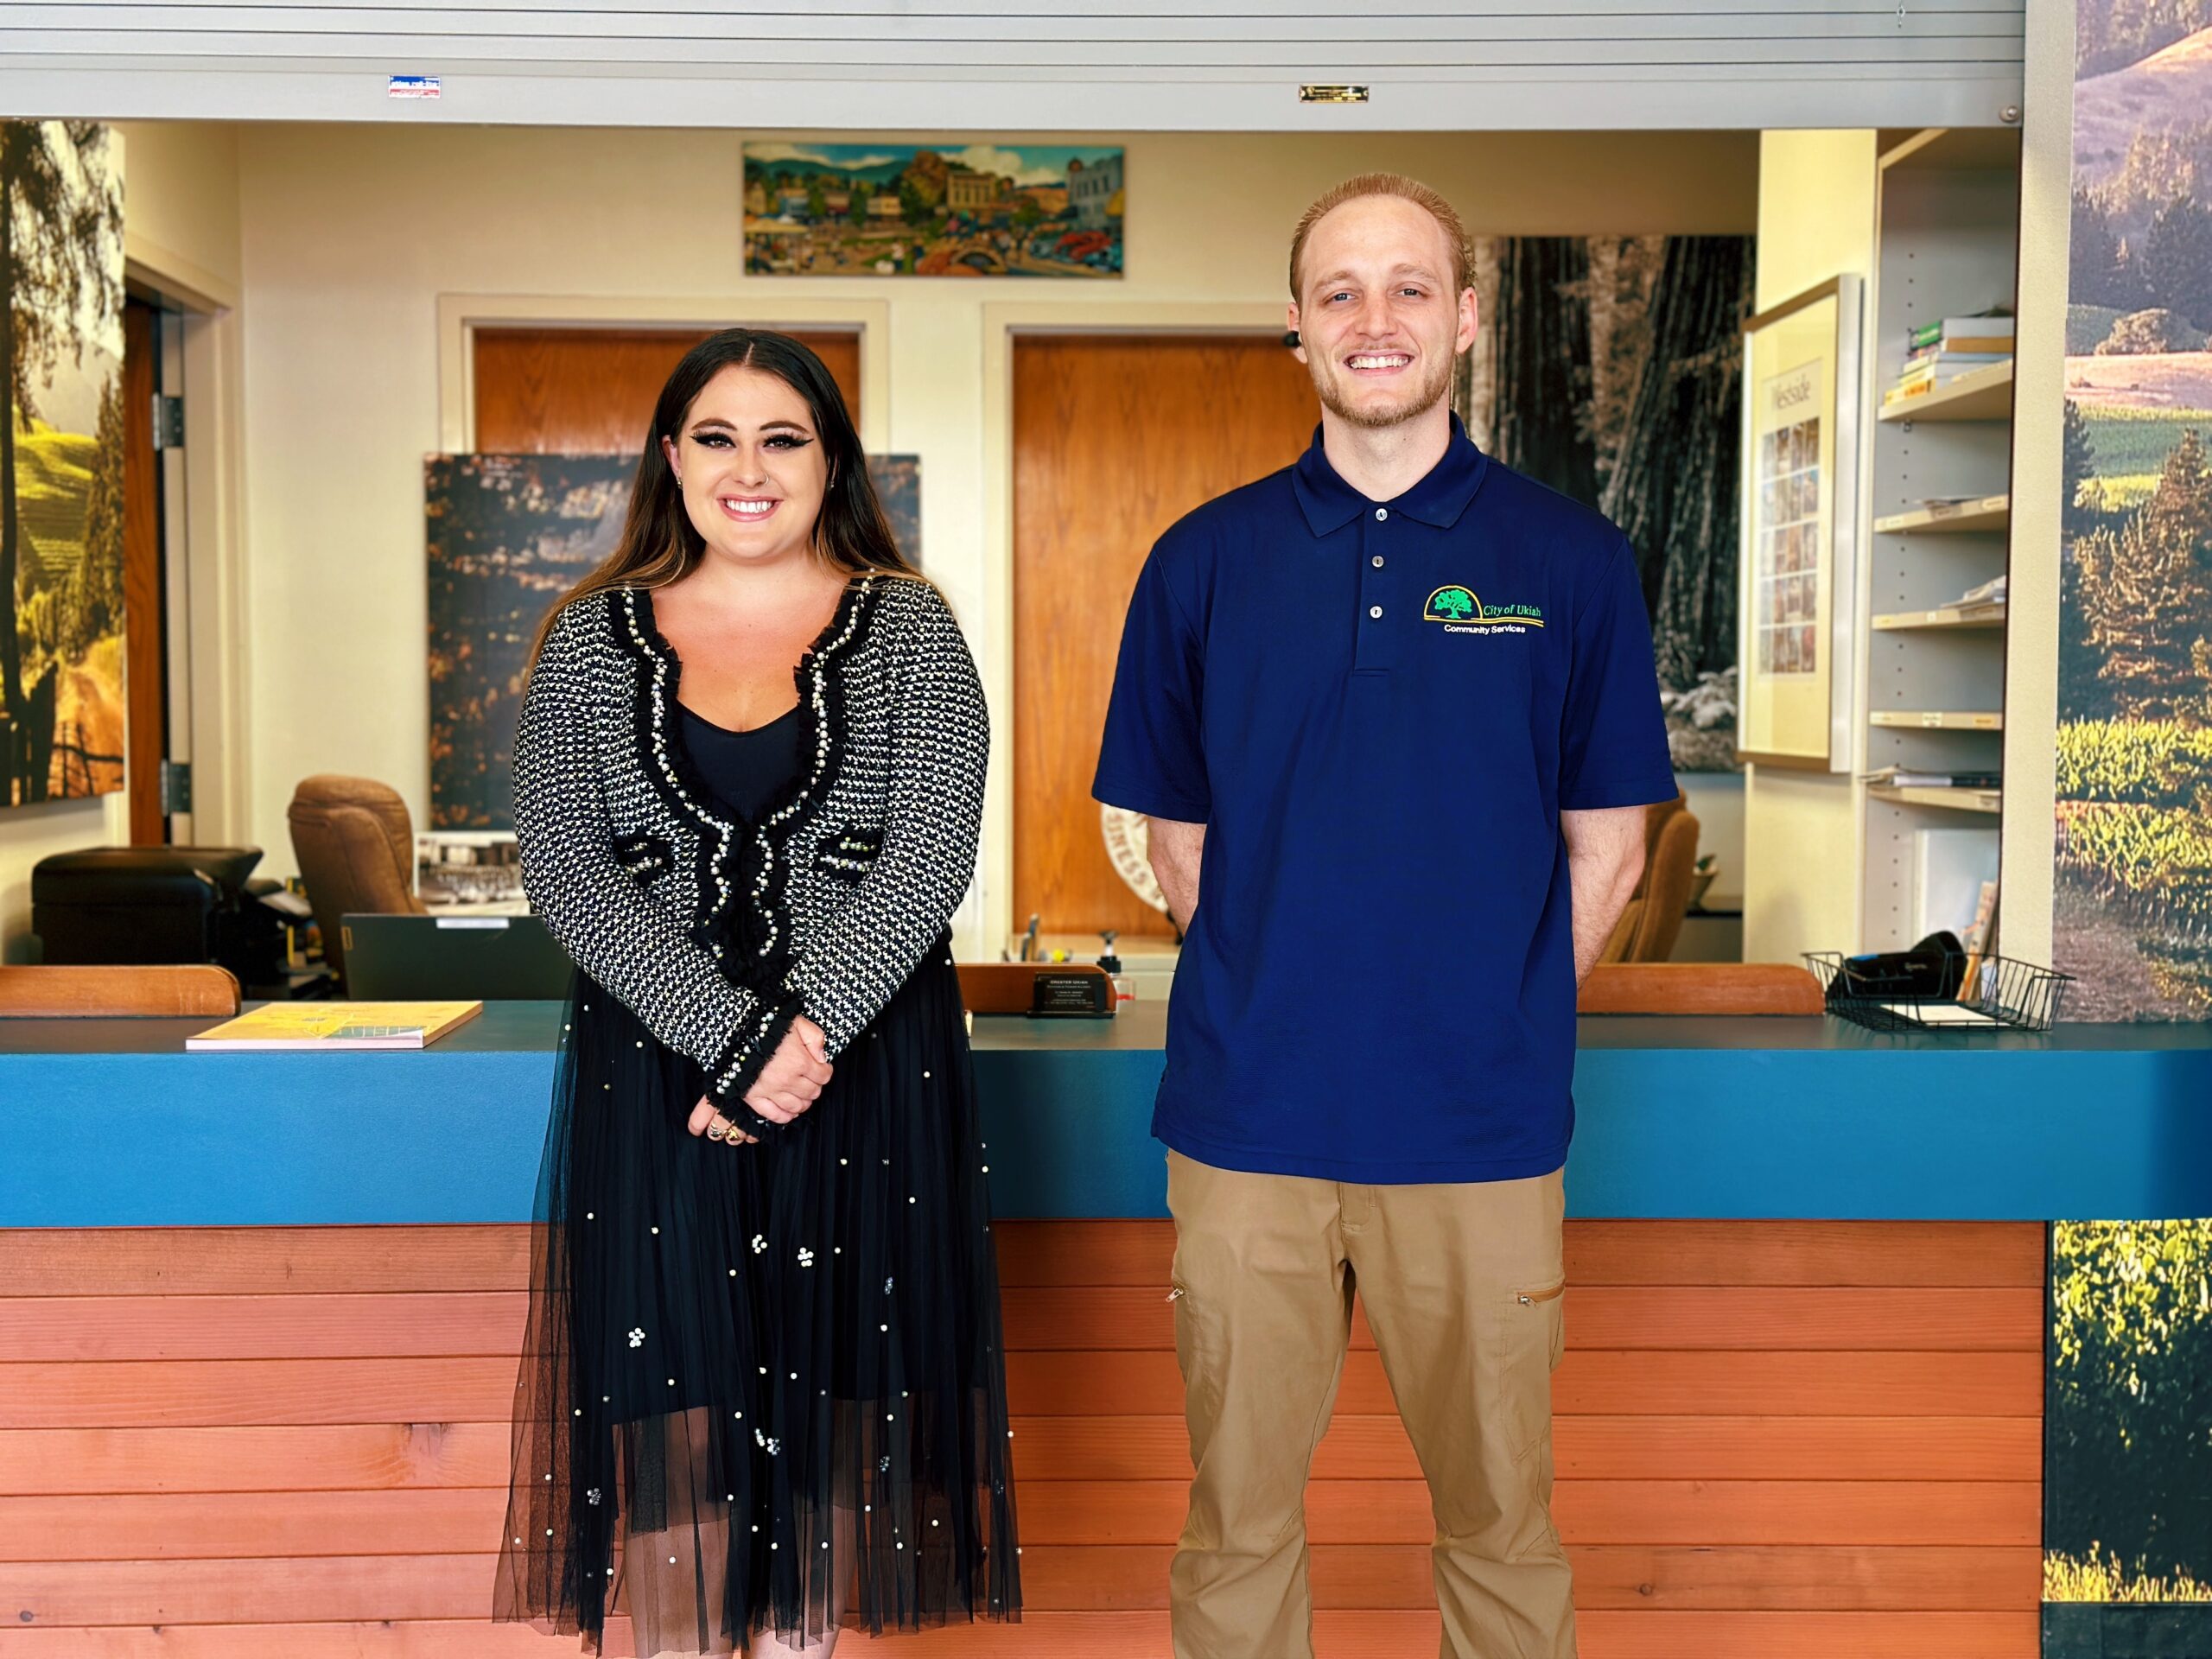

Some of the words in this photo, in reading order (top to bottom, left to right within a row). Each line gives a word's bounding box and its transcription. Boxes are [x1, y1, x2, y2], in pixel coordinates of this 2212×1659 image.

[1483, 605, 1503, 617] City
[1503, 604, 1516, 614] of
[1516, 605, 1541, 617] Ukiah
[1444, 624, 1491, 635] Community
[1491, 624, 1526, 633] Services
